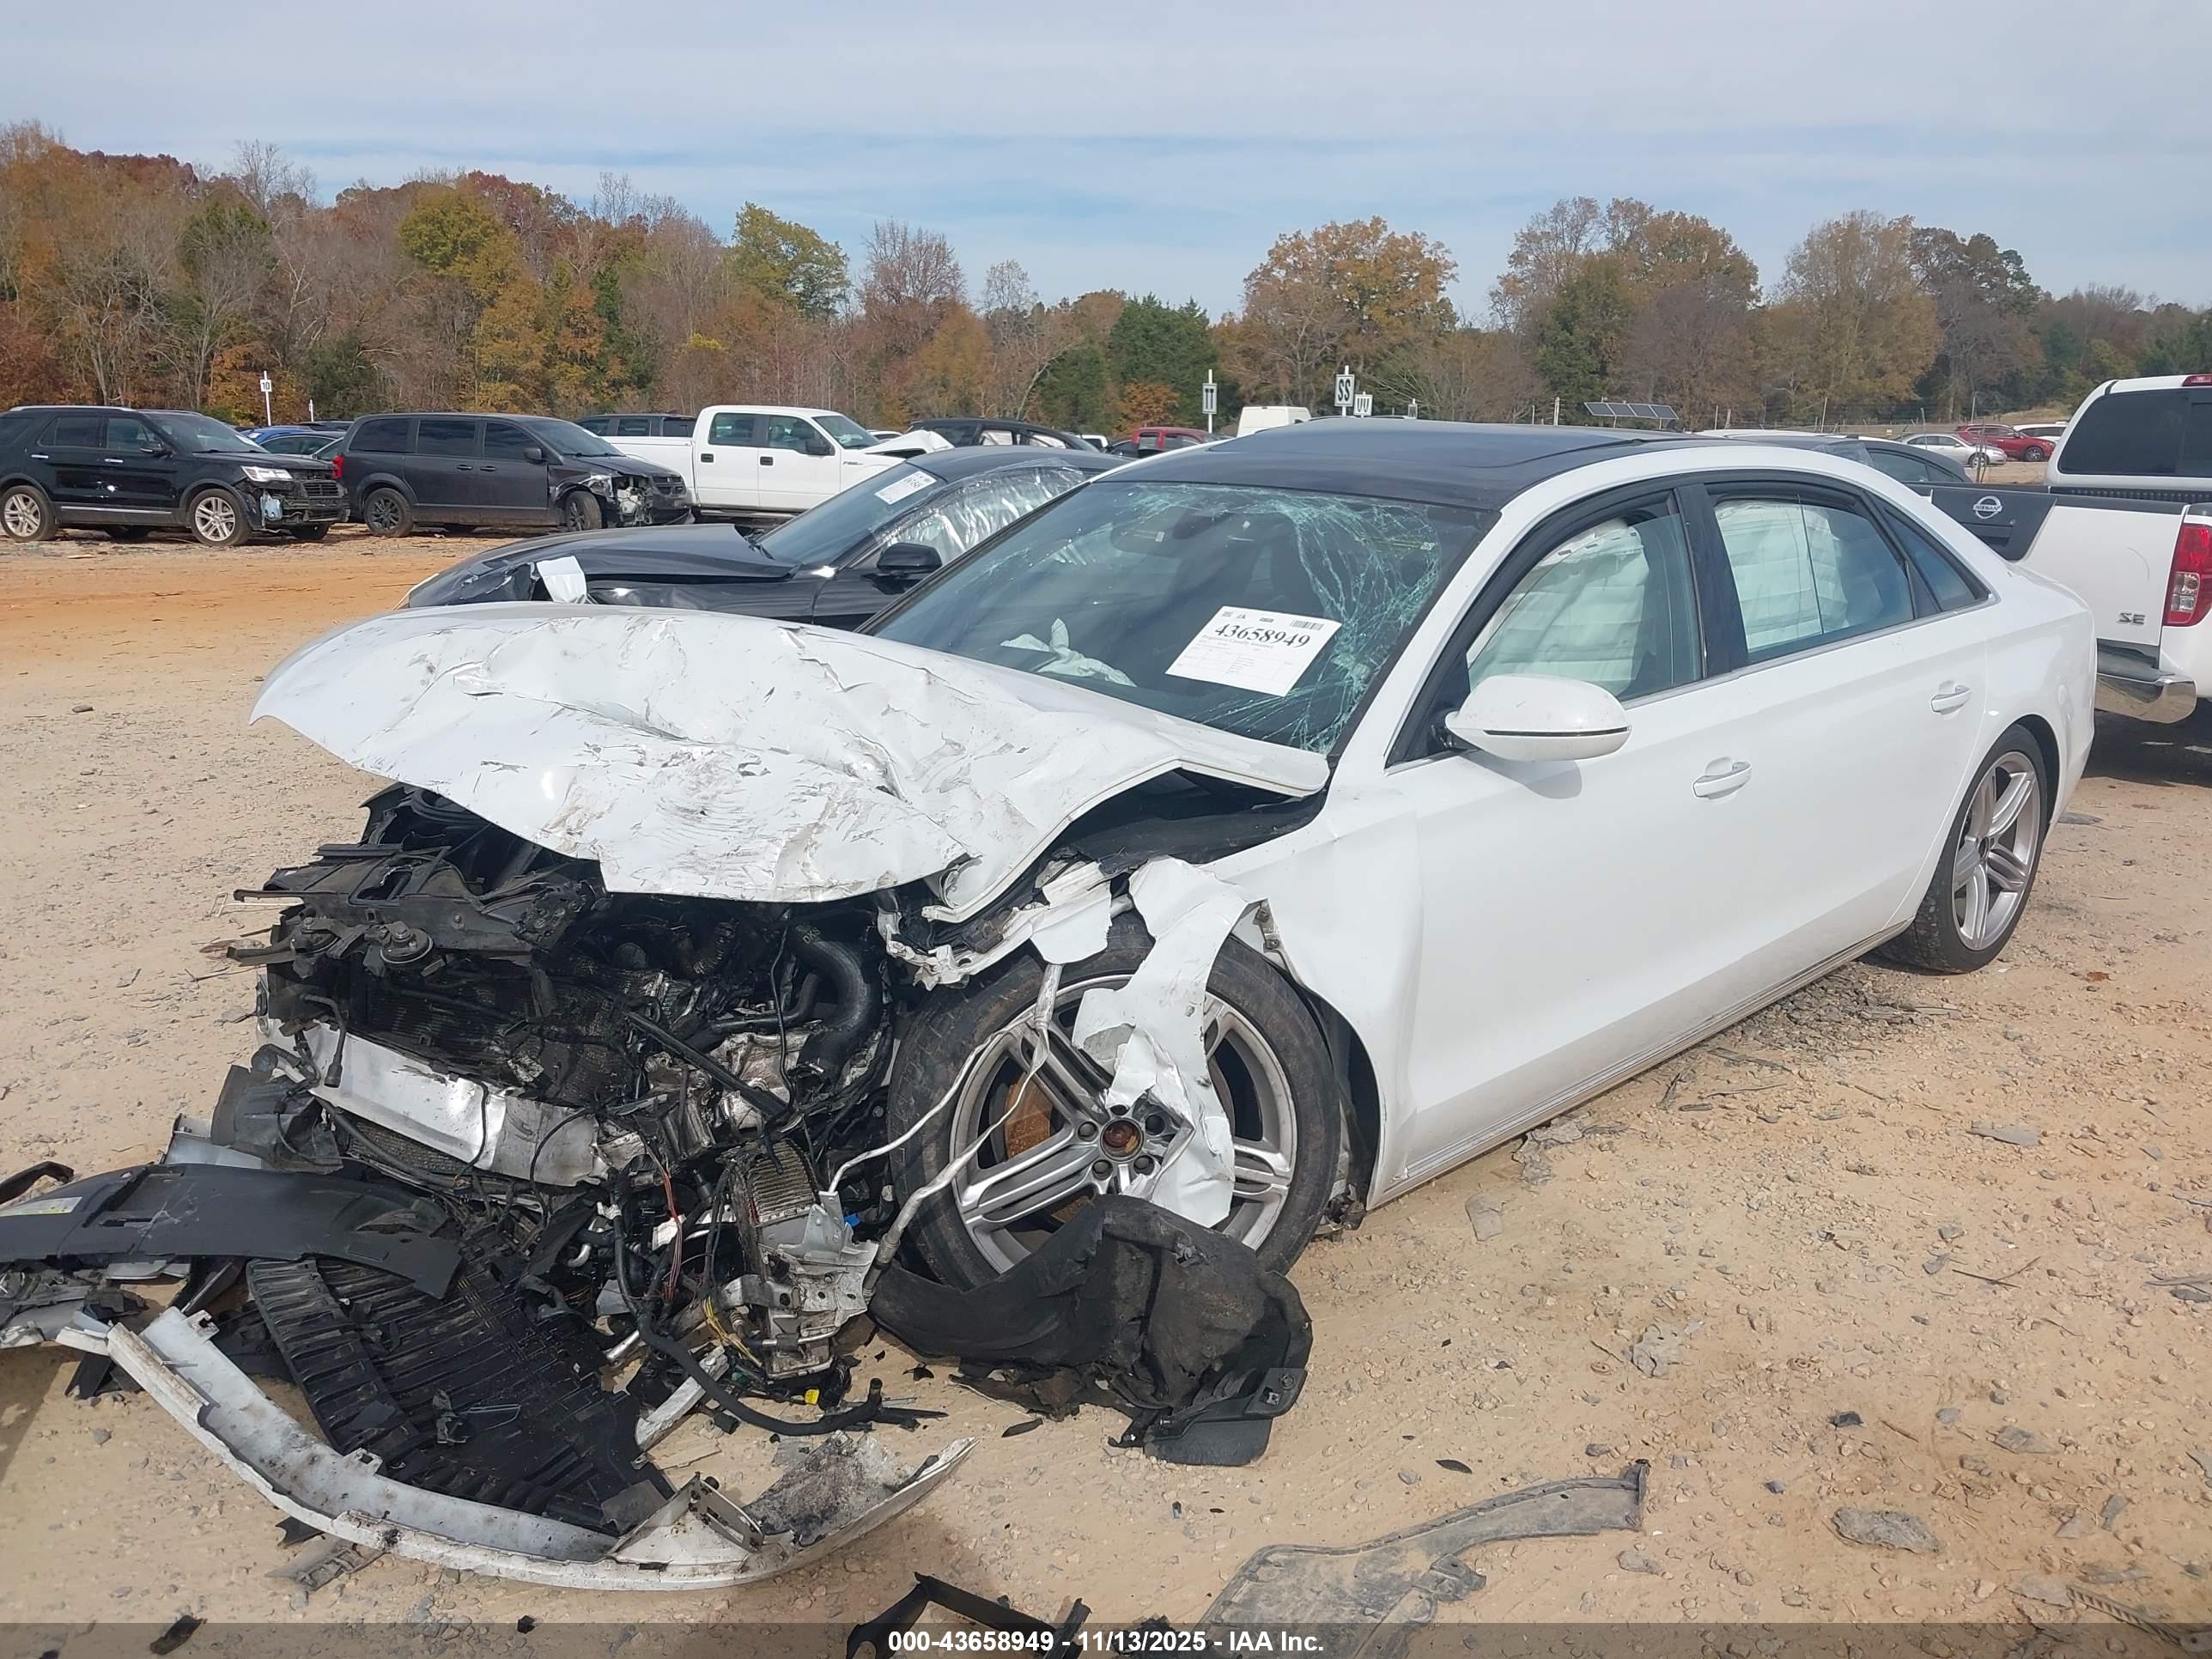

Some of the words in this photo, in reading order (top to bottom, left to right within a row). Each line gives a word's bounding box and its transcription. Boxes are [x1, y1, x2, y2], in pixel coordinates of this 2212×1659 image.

[1205, 388, 1214, 410] TT
[1338, 379, 1351, 402] SS
[2118, 612, 2145, 625] SE
[1215, 623, 1310, 648] 43658949
